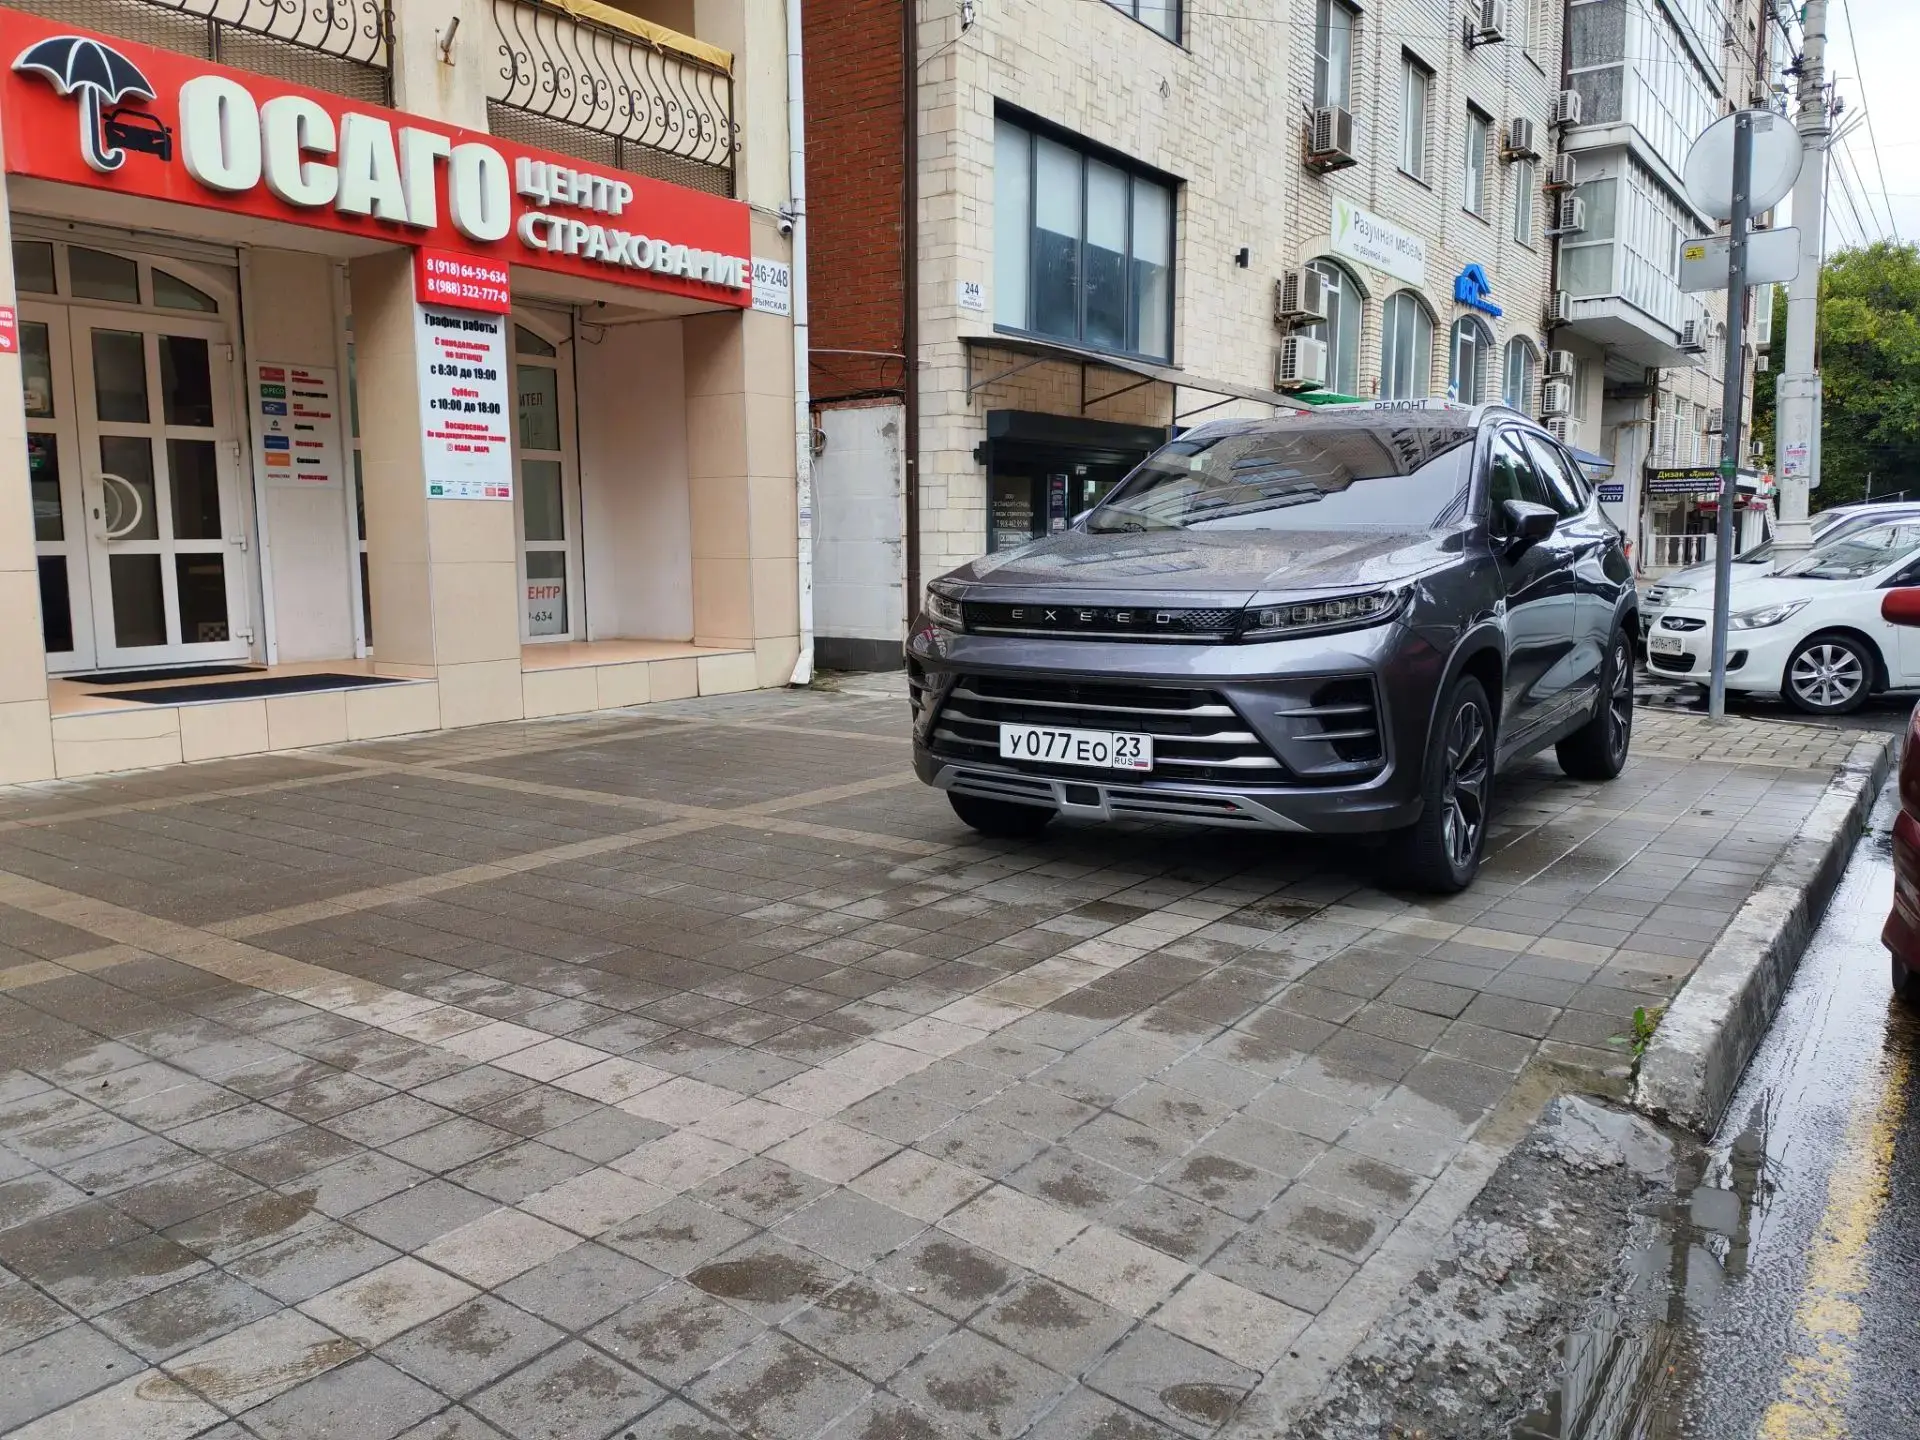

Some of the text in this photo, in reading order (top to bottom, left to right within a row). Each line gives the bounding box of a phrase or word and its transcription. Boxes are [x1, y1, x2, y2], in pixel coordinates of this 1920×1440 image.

[179, 75, 511, 241] ОСАГО
[515, 157, 633, 215] ЦЕНТР
[1354, 211, 1422, 261] Разумная мебель
[517, 211, 750, 289] СТРАХОВАНИЕ
[427, 258, 507, 284] 8 (918) 64-59-634
[428, 278, 508, 303] 8 (988) 322-777-0
[965, 282, 979, 296] 244
[425, 313, 498, 334] График работы
[438, 363, 458, 377] 8:30
[460, 367, 472, 379] до
[474, 368, 497, 381] 19:00
[268, 386, 285, 395] РЕСО
[452, 387, 479, 398] Суббота
[438, 398, 462, 411] 10:00
[464, 402, 476, 413] до
[477, 402, 501, 414] 18:00
[1374, 400, 1428, 411] РЕМОНТ
[528, 585, 561, 600] ЕНТР
[1011, 609, 1171, 623] EXEED
[1115, 736, 1141, 758] 23
[1114, 757, 1133, 766] RUS
